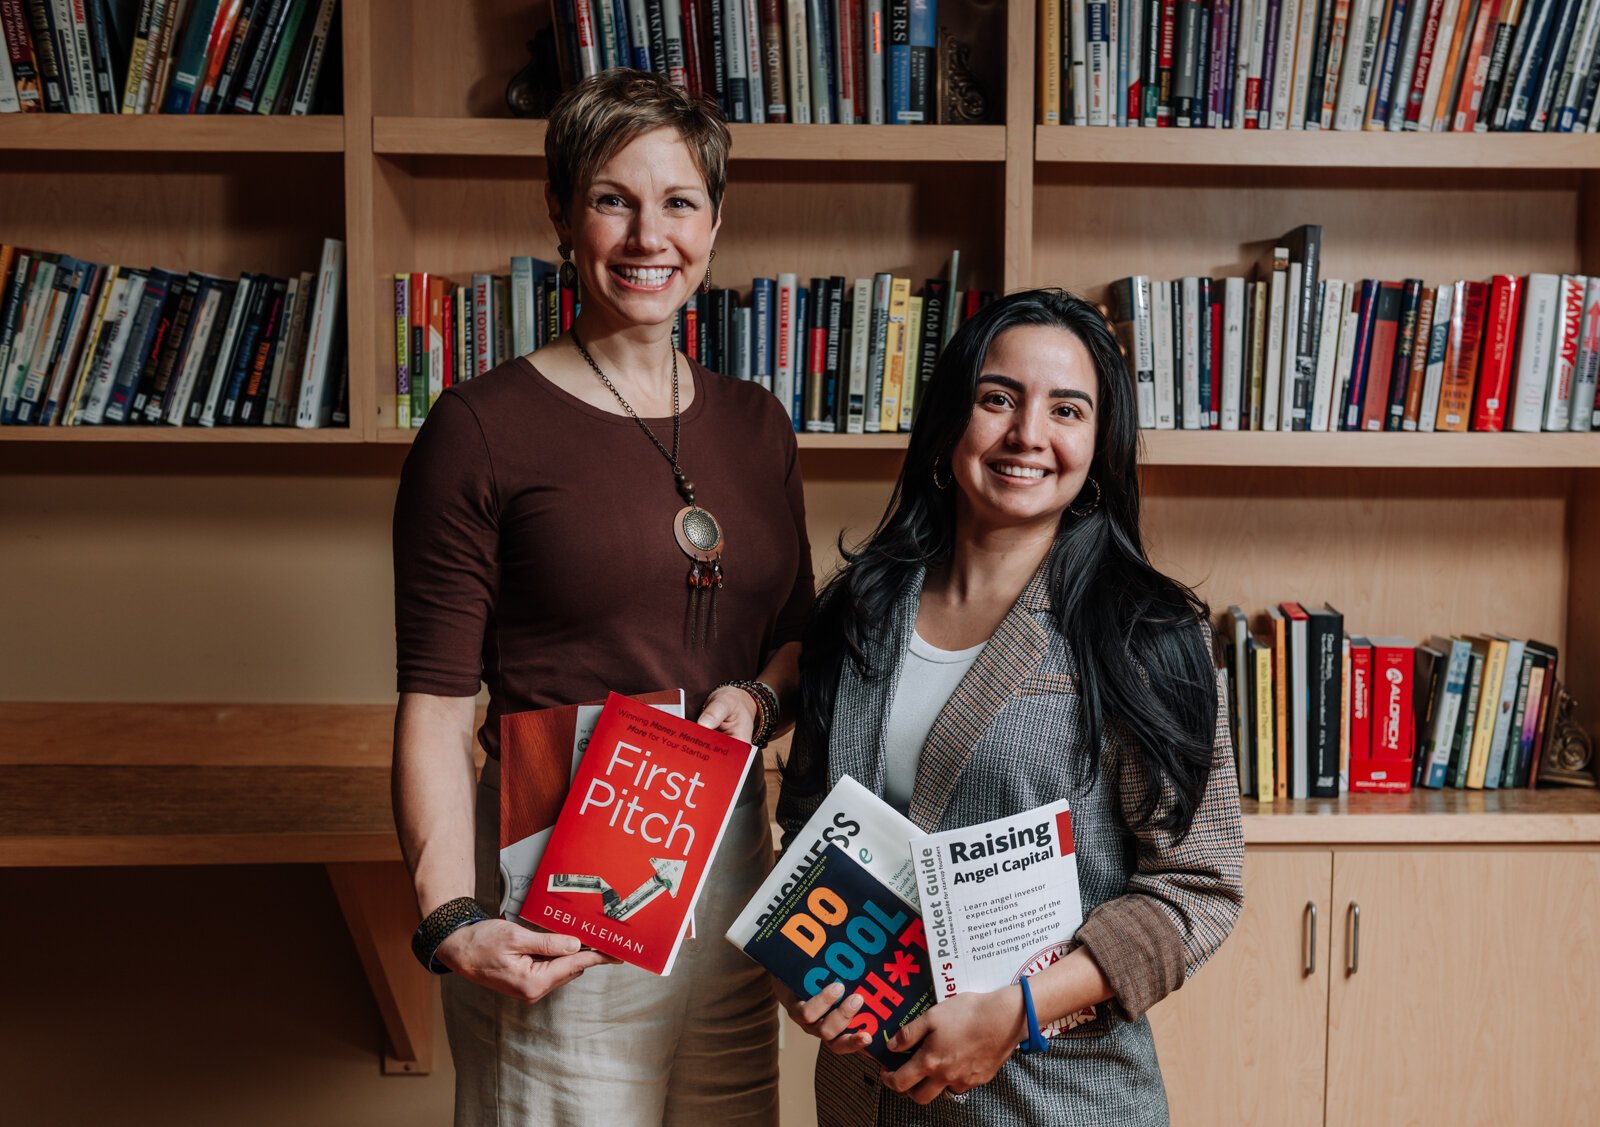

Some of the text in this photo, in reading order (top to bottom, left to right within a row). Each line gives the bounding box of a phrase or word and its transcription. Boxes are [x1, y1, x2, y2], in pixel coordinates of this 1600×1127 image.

[649, 3, 665, 51] TAKING
[665, 38, 684, 67] BENCH
[1414, 17, 1438, 89] Global Brand
[477, 283, 487, 307] THE
[476, 310, 488, 356] TOYOTA
[921, 299, 940, 381] GEMBA KAIZEN
[1138, 314, 1150, 368] Innovation
[1430, 324, 1447, 361] GOAL
[1561, 278, 1584, 368] MAYDAY
[1413, 345, 1427, 373] LEAN
[398, 365, 410, 394] book
[1355, 668, 1367, 719] Labware
[618, 708, 729, 757] Winning Money, Mentors, and
[1387, 683, 1401, 750] ALDRICH
[627, 724, 710, 761] More for Your Startup
[605, 740, 705, 809] First
[579, 777, 696, 857] Pitch
[936, 846, 944, 871] founders
[949, 822, 1052, 864] Raising
[892, 858, 912, 880] Woman's
[896, 877, 910, 892] Guide
[920, 847, 939, 896] Guide
[941, 871, 949, 892] startup
[953, 846, 1054, 886] Angel Capital
[964, 883, 1046, 912] Learn angel investor
[965, 901, 1019, 920] expectations
[967, 899, 1061, 933] Review each step of the
[543, 905, 644, 955] DEBI KLEIMAN
[780, 886, 849, 959] DO
[929, 901, 950, 958] Pocket
[969, 910, 1056, 941] angel funding process
[971, 921, 1061, 953] Avoid common startup
[803, 900, 909, 1006] COOL
[972, 934, 1049, 961] fundraising pitfalls
[899, 1015, 910, 1027] QUIT
[908, 1002, 921, 1016] YOUR
[920, 991, 929, 1003] DAY
